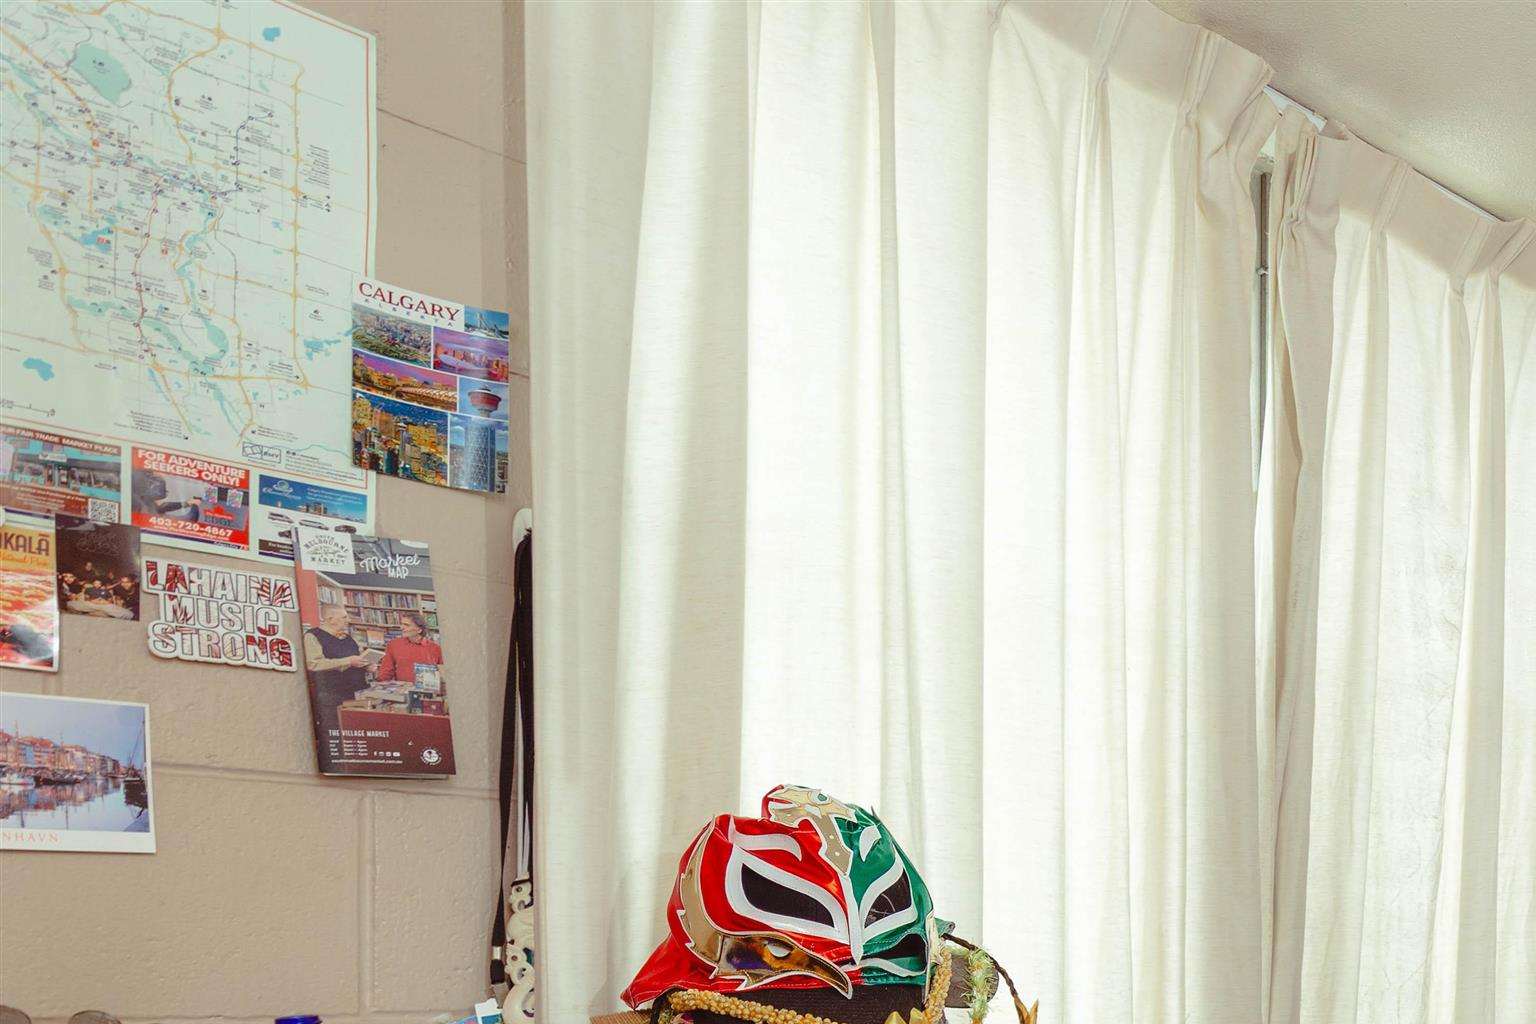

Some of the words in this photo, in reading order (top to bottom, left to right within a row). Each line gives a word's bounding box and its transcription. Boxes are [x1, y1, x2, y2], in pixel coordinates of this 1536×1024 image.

[359, 282, 460, 321] CALGARY
[364, 298, 453, 327] ALBERTA
[35, 431, 60, 442] TRADE
[62, 438, 94, 450] MARKET
[94, 444, 119, 454] PLACE
[138, 449, 166, 462] FOR
[168, 455, 246, 479] ADVENTURE
[144, 460, 199, 478] SEEKERS
[201, 471, 240, 487] ONLY!
[149, 516, 233, 537] 403-720-4867
[0, 532, 50, 556] KALĀ
[304, 539, 349, 553] MELBOURNE
[360, 553, 421, 573] Market
[387, 566, 409, 579] MAP
[146, 560, 295, 609] LAHAINA
[164, 593, 279, 636] MUSIC
[152, 622, 293, 667] STRONG
